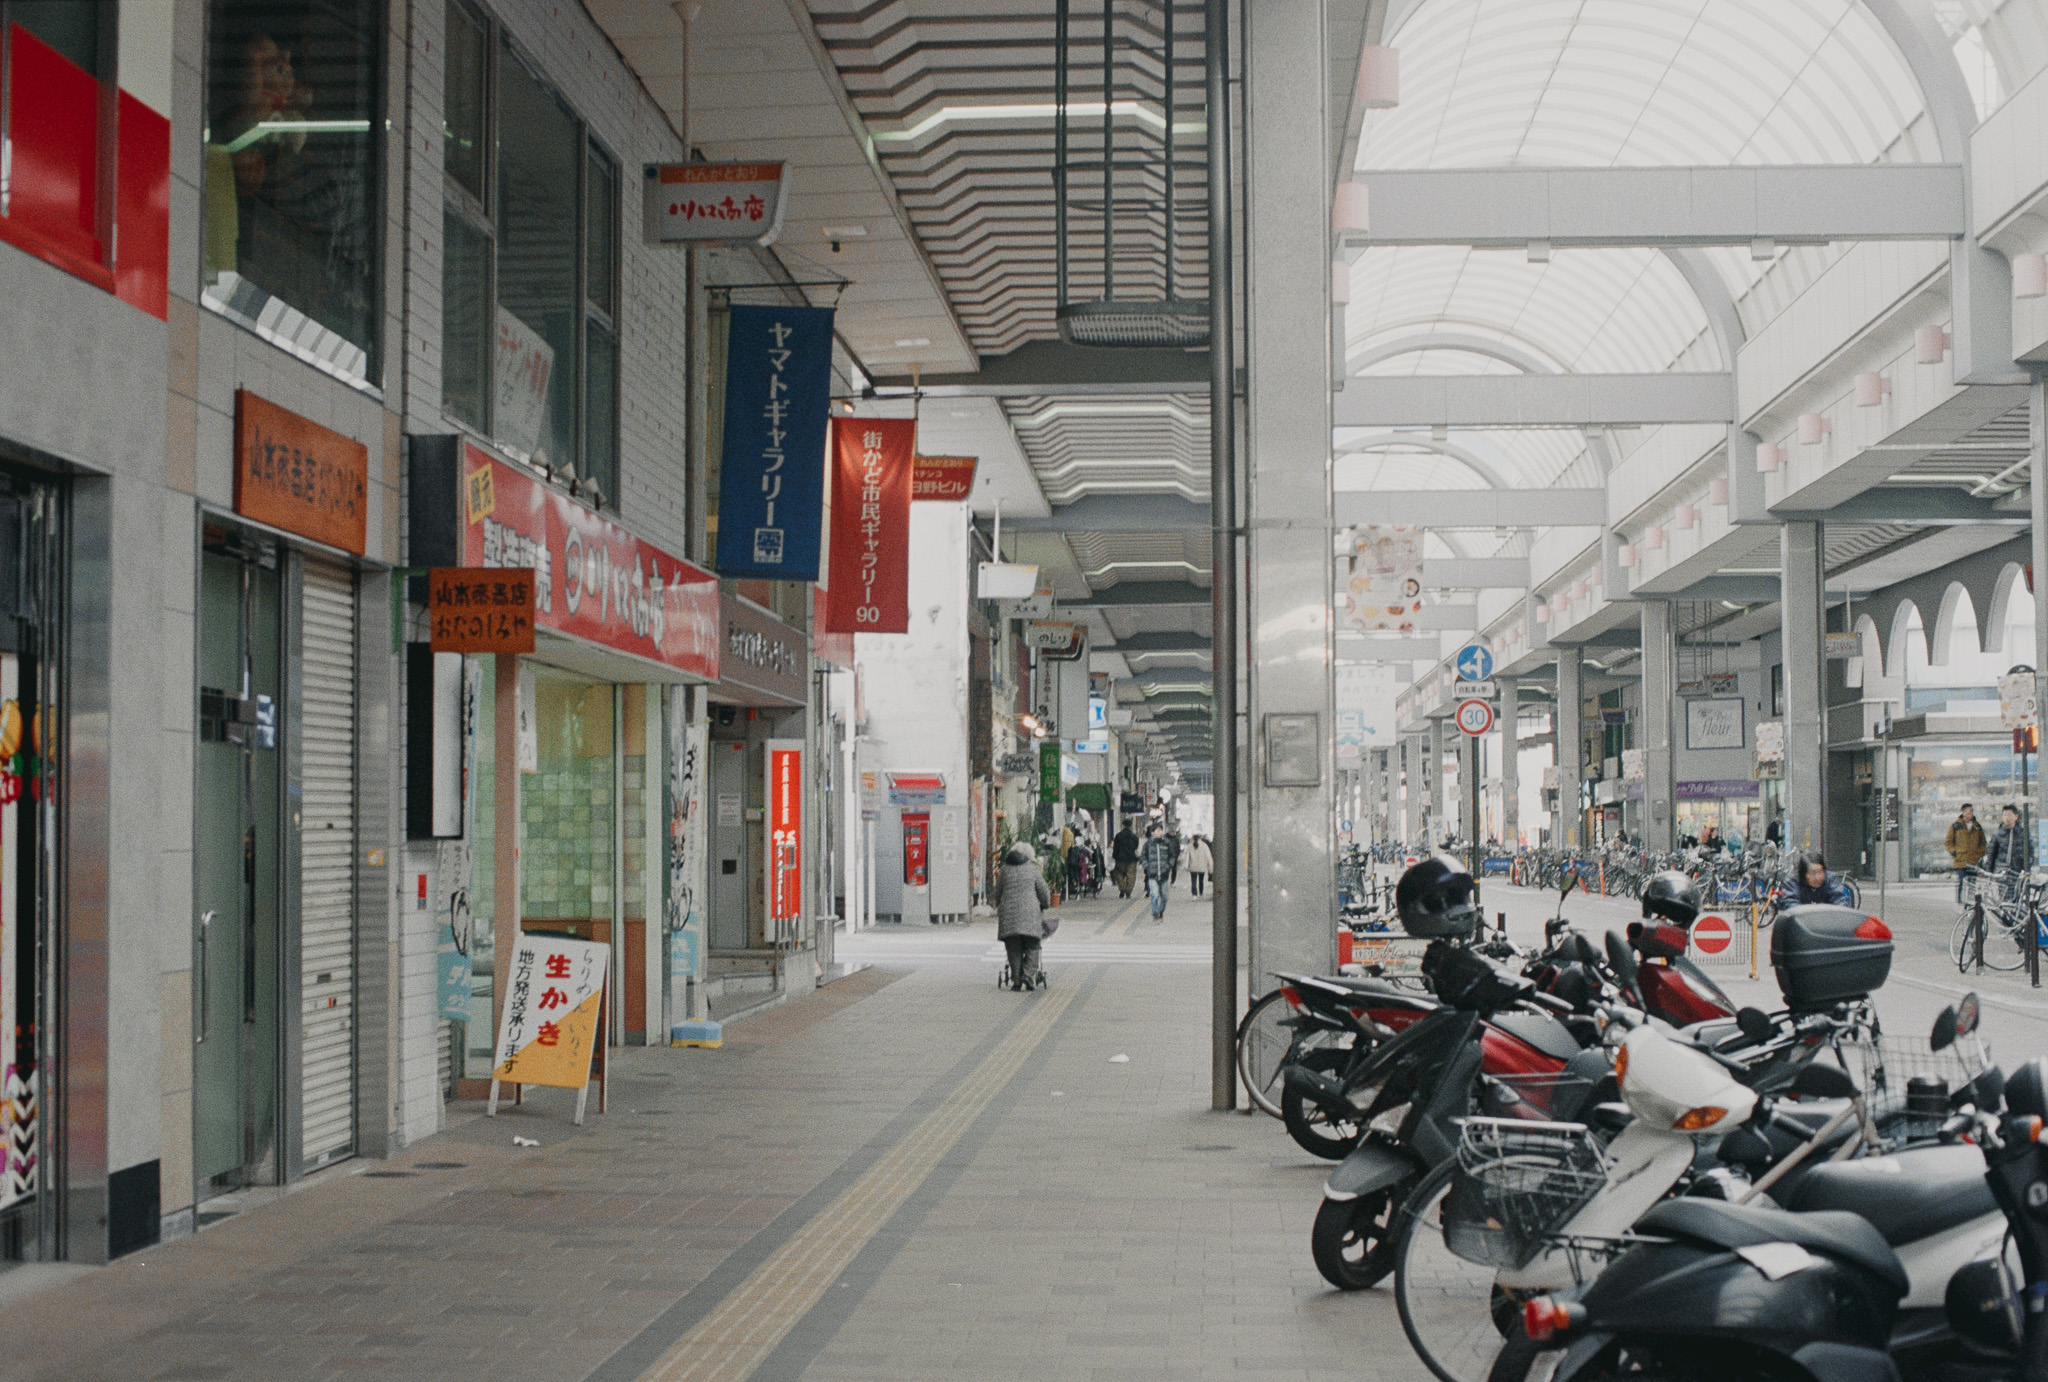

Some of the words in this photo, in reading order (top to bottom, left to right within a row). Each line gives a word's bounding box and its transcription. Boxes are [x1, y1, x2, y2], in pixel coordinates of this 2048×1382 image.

[669, 194, 764, 221] 川口商店
[761, 321, 792, 527] ヤマトギャラリー
[1464, 709, 1485, 726] 30
[503, 949, 535, 1074] 地方発送承ります
[537, 953, 572, 1047] 生かき
